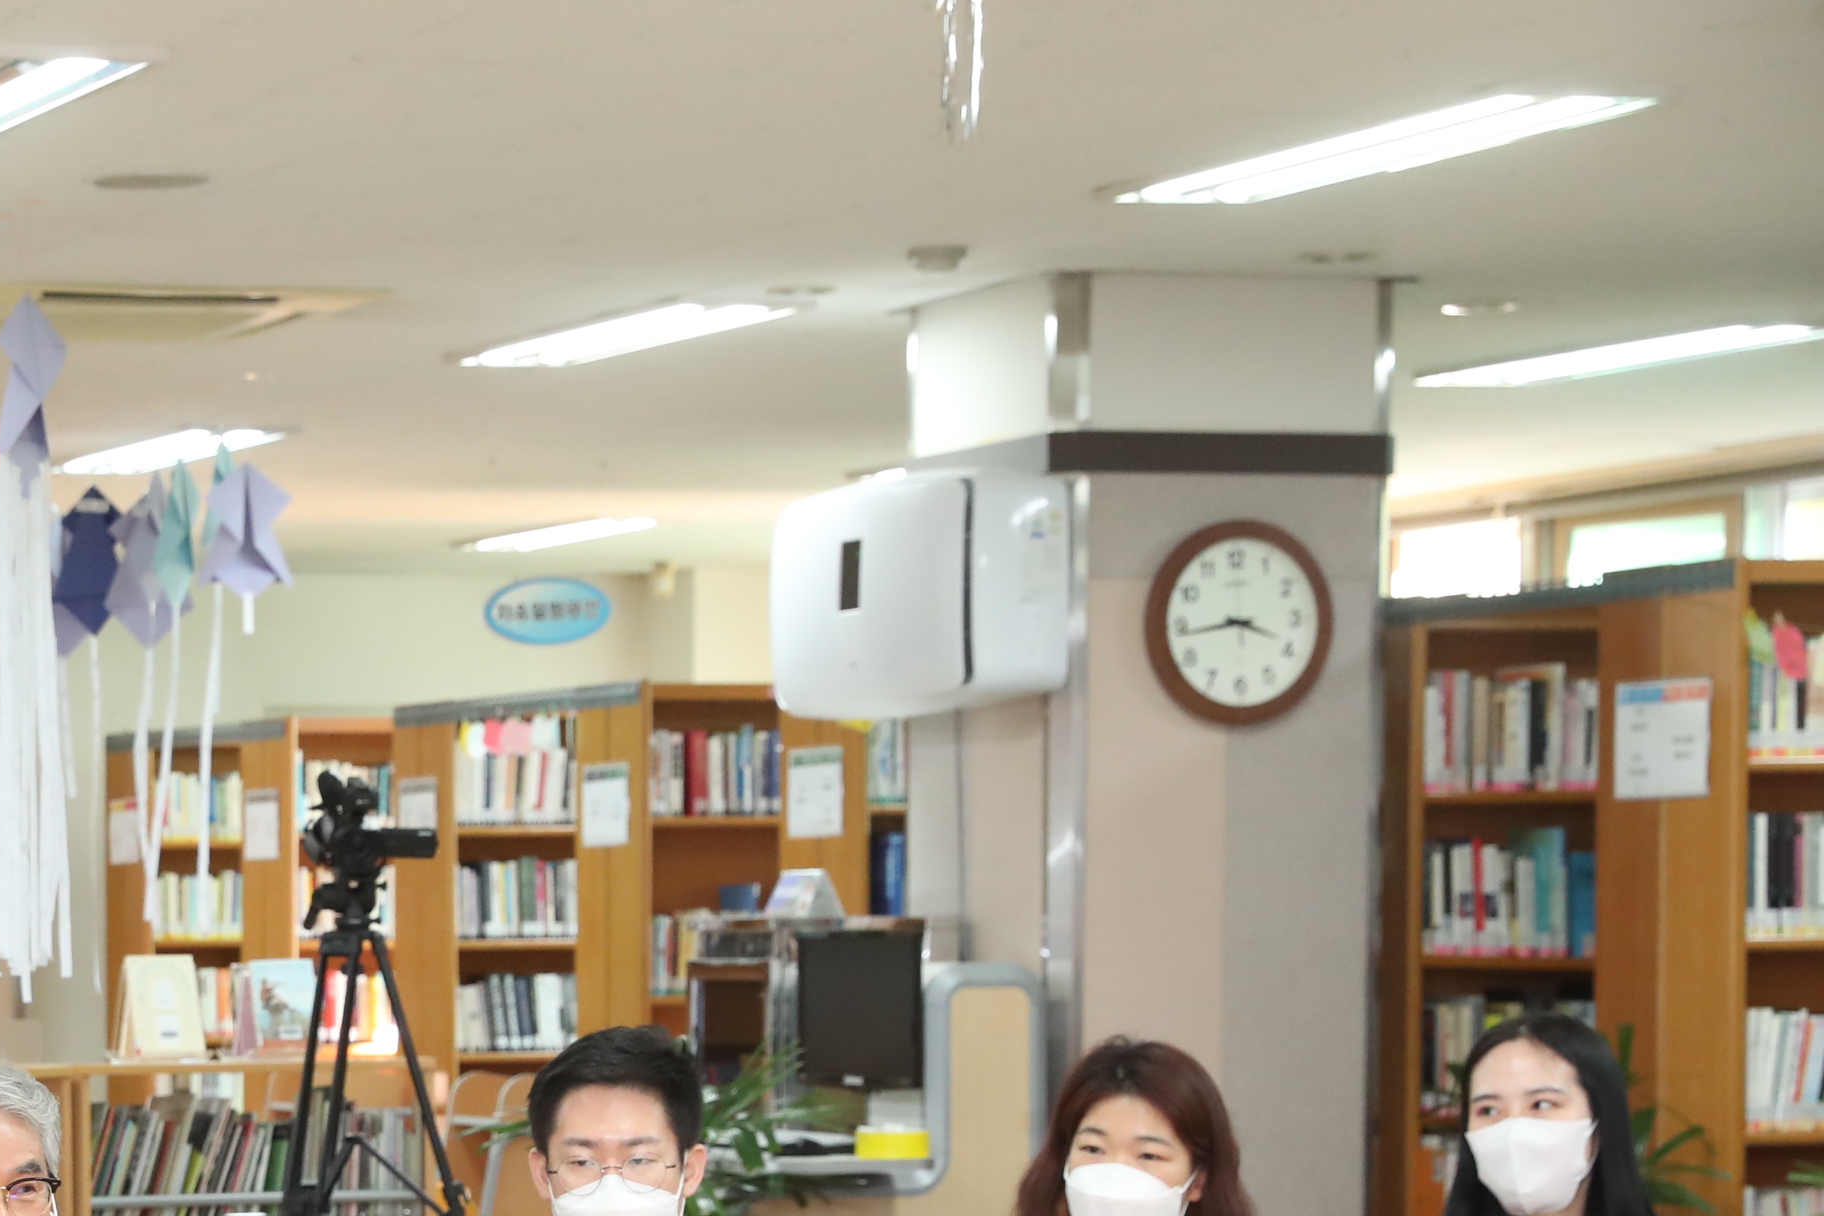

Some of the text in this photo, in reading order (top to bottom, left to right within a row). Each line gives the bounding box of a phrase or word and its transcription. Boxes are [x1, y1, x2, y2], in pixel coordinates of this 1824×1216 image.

[1200, 560, 1216, 578] 11
[1228, 549, 1246, 570] 12
[1181, 584, 1200, 604] 10
[1280, 577, 1294, 598] 2
[1175, 616, 1189, 637] 9
[1288, 608, 1303, 629] 3
[1182, 647, 1198, 668] 8
[1281, 641, 1295, 659] 4
[1206, 668, 1218, 689] 7
[1261, 664, 1276, 686] 5
[1232, 675, 1249, 697] 6
